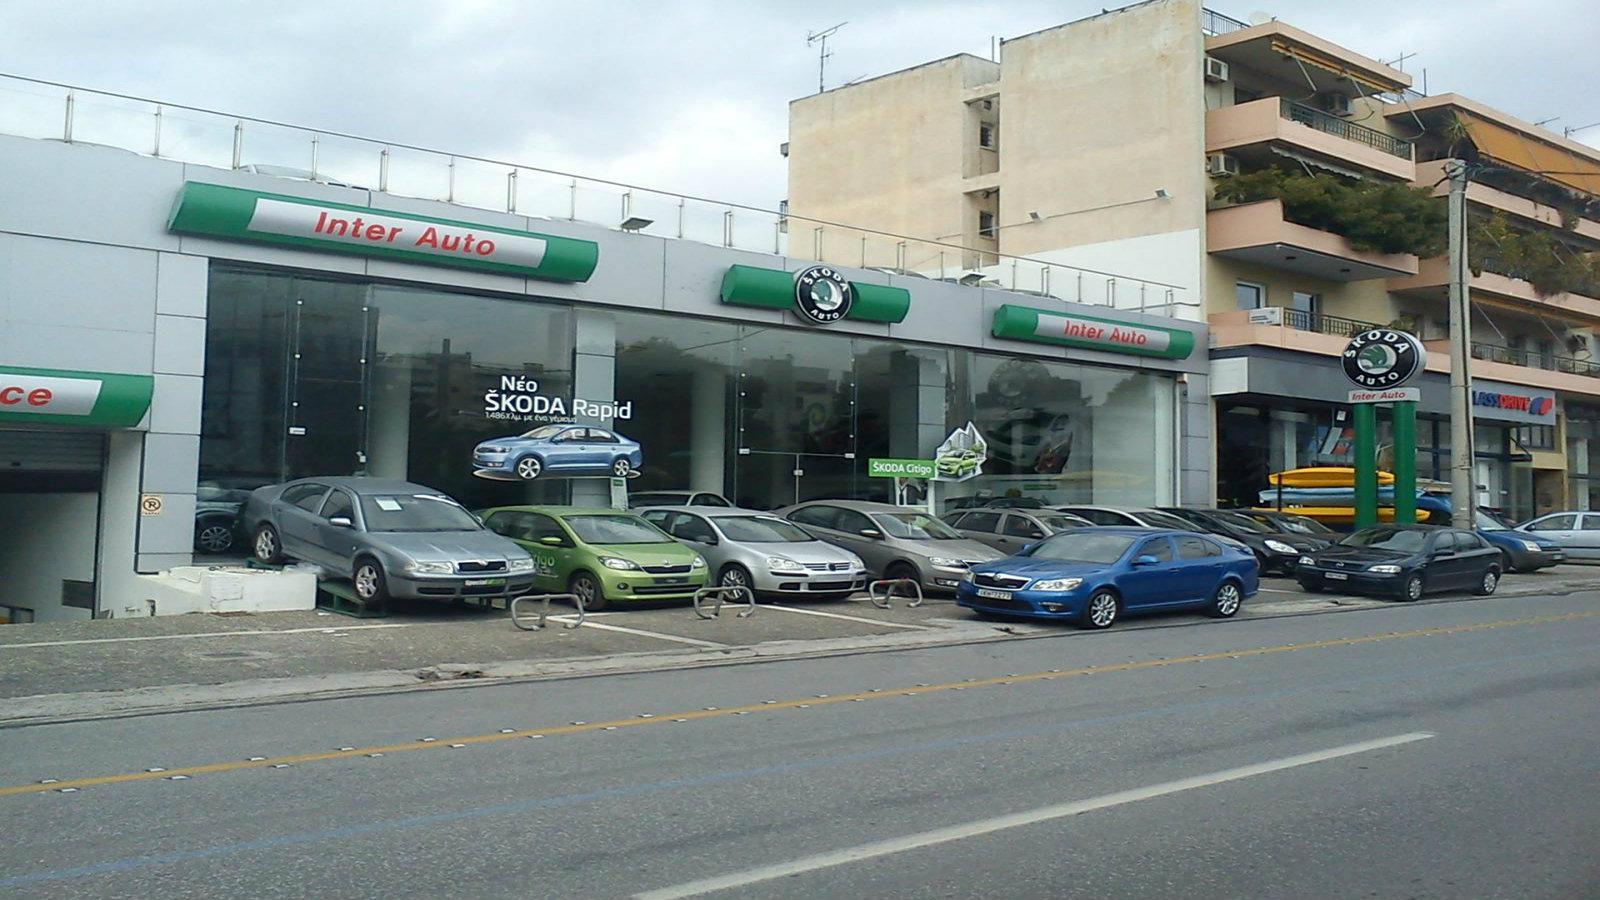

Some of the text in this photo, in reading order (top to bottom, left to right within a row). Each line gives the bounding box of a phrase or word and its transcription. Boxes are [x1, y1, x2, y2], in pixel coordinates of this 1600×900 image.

[314, 211, 496, 256] Inter Auto
[811, 309, 839, 320] AUTO
[1064, 320, 1147, 345] Inter Auto
[501, 375, 537, 393] Νέο
[1356, 372, 1399, 385] AUTO
[1352, 391, 1406, 401] Inter Auto
[485, 389, 632, 422] ŠKODA Rapid
[873, 461, 932, 476] ŠKODA Citigo
